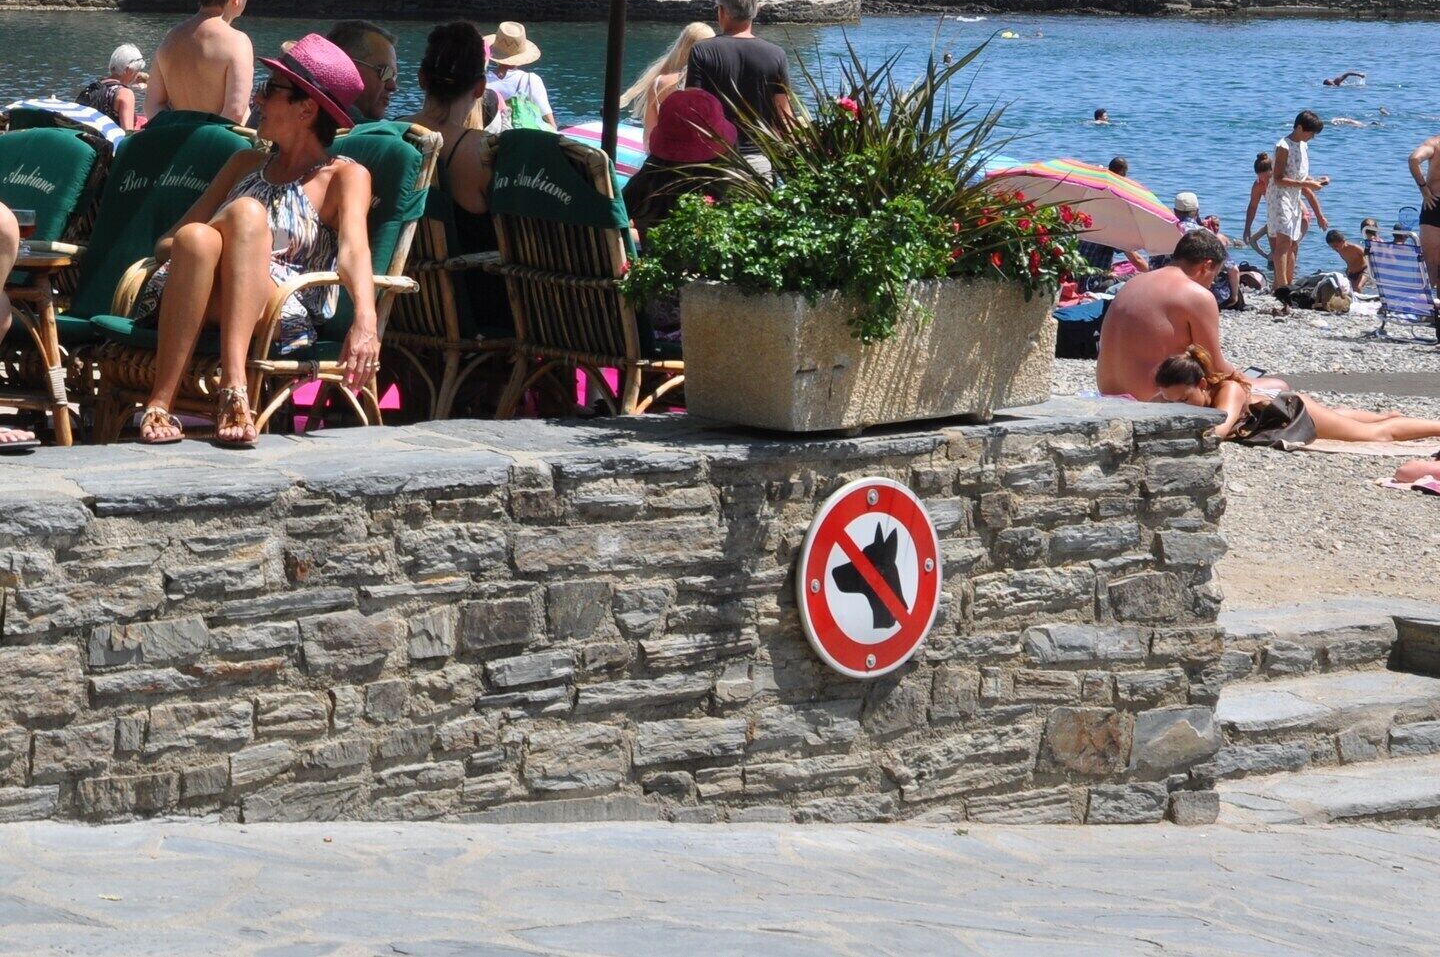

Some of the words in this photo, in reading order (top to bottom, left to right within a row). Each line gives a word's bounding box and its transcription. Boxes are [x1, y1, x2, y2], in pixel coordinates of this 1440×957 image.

[3, 164, 56, 195] Ambiance
[119, 170, 148, 193] Bar
[152, 164, 209, 192] Ambianc
[512, 164, 573, 205] Ambiance
